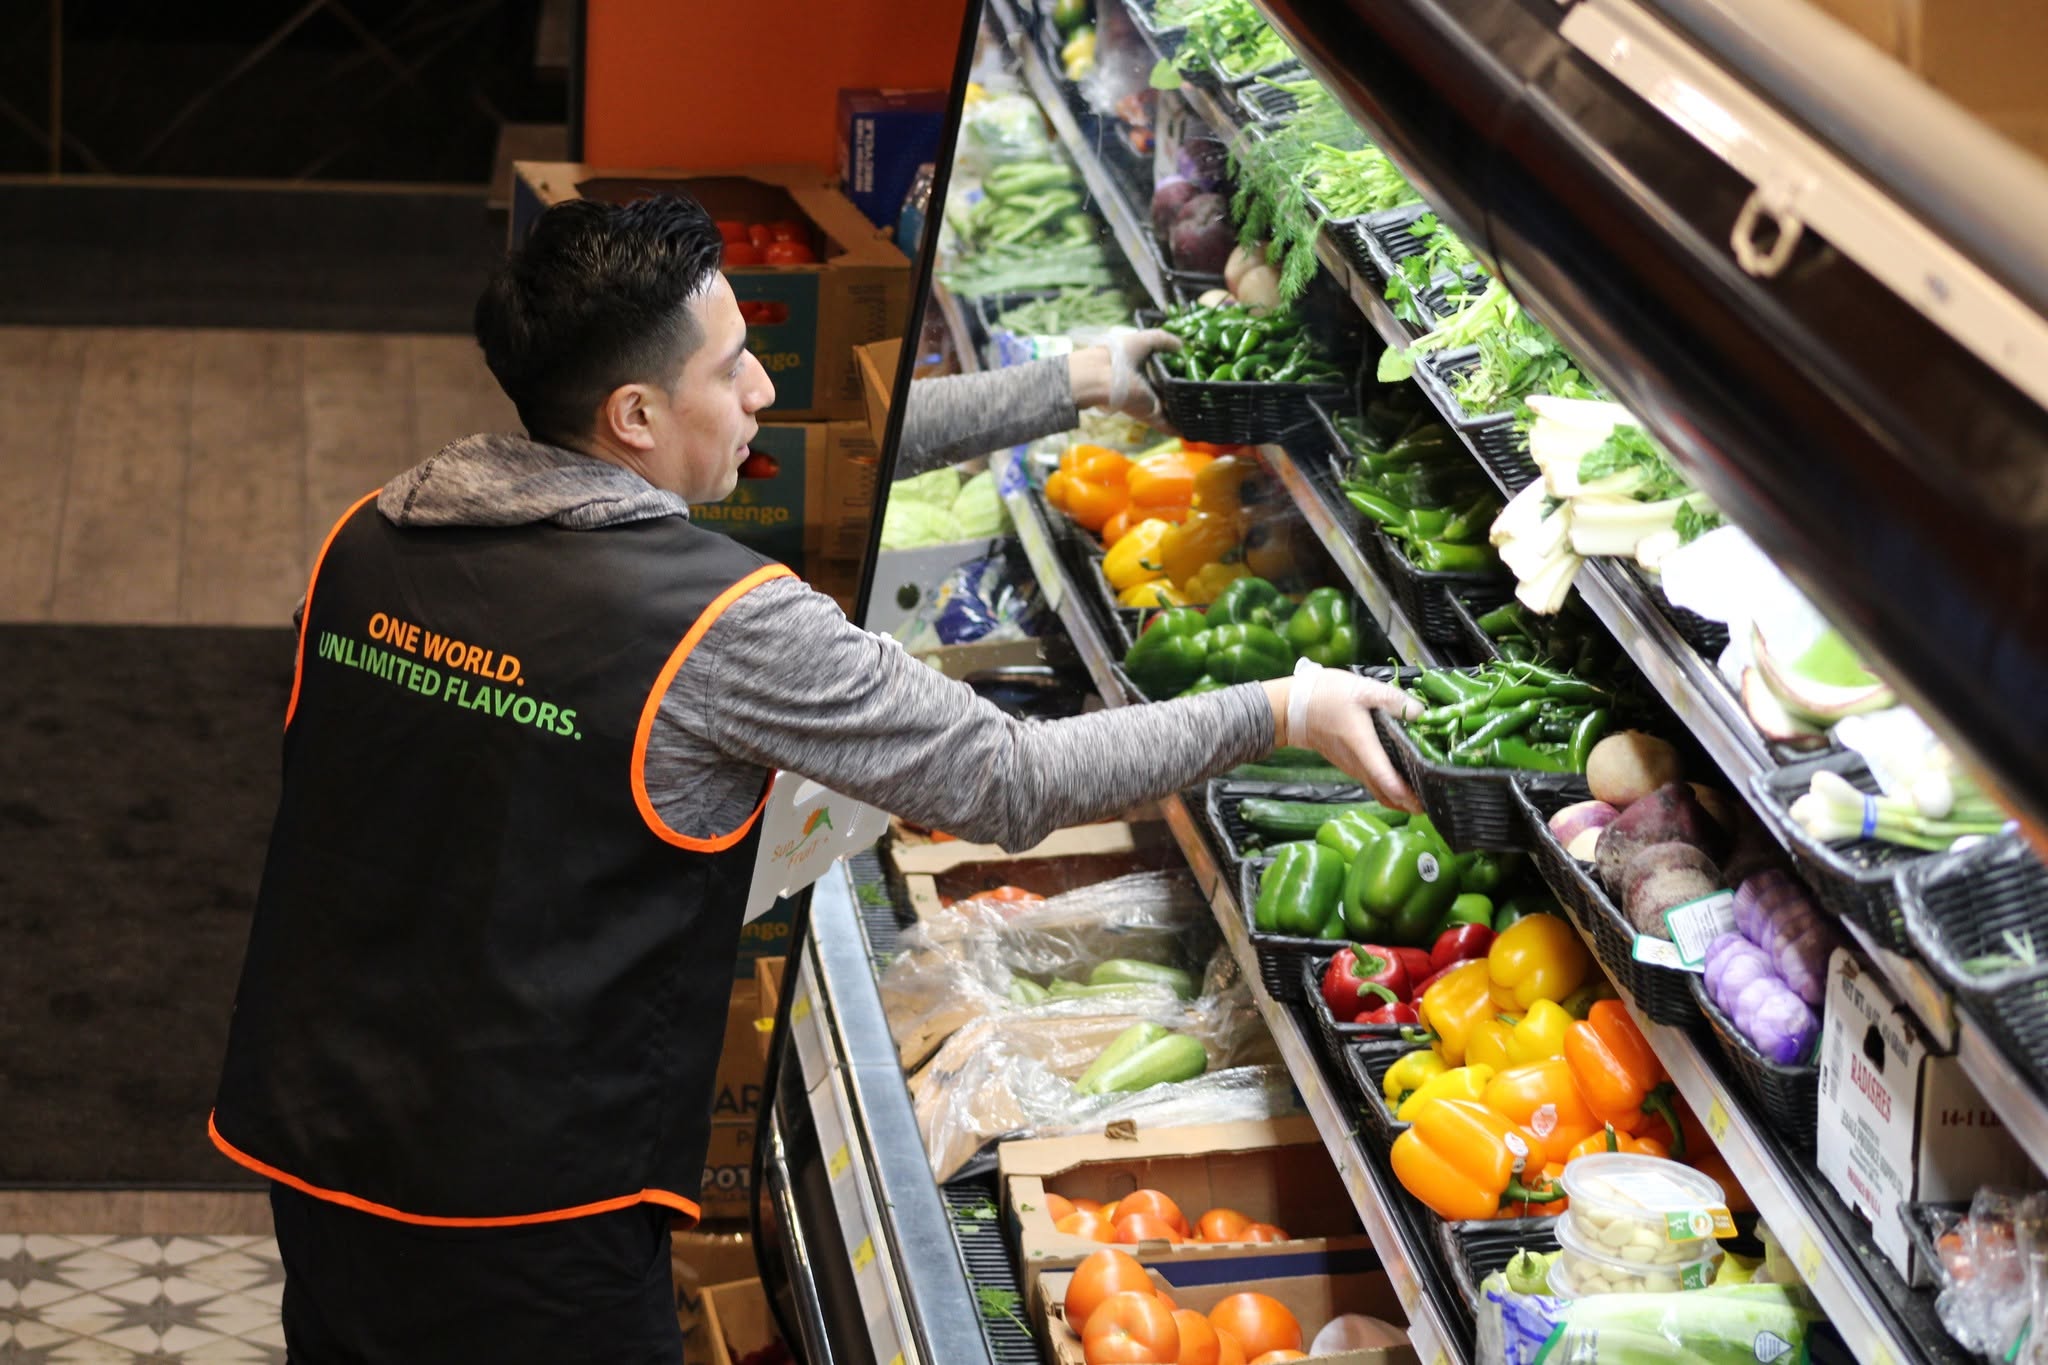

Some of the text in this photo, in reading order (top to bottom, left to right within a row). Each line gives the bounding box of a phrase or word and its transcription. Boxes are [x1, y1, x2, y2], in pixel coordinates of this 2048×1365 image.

[318, 631, 582, 741] UNLIMITED FLAVORS.
[368, 612, 525, 687] ONE WORLD.
[1850, 1053, 1892, 1123] RADISHES
